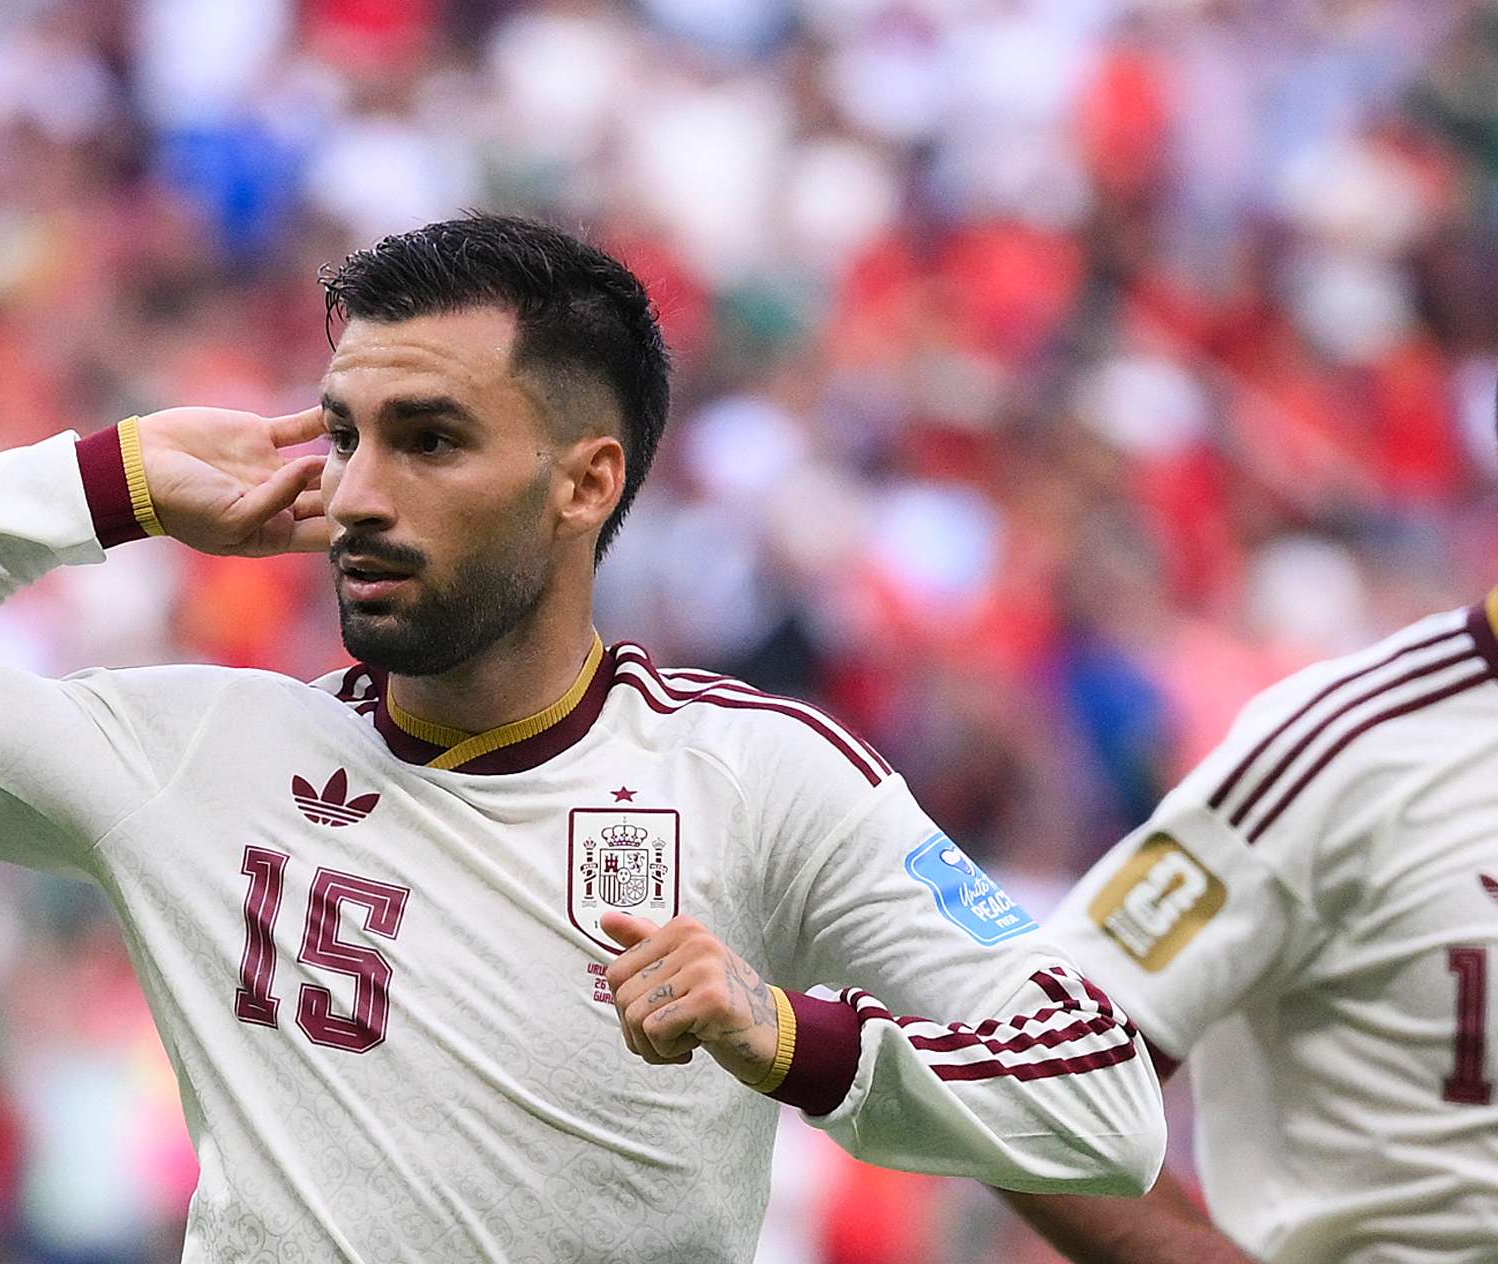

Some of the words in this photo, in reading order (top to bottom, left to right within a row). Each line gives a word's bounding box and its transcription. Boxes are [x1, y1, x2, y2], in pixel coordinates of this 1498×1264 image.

[235, 845, 411, 1054] 15
[587, 963, 608, 976] URU
[594, 977, 607, 990] 26
